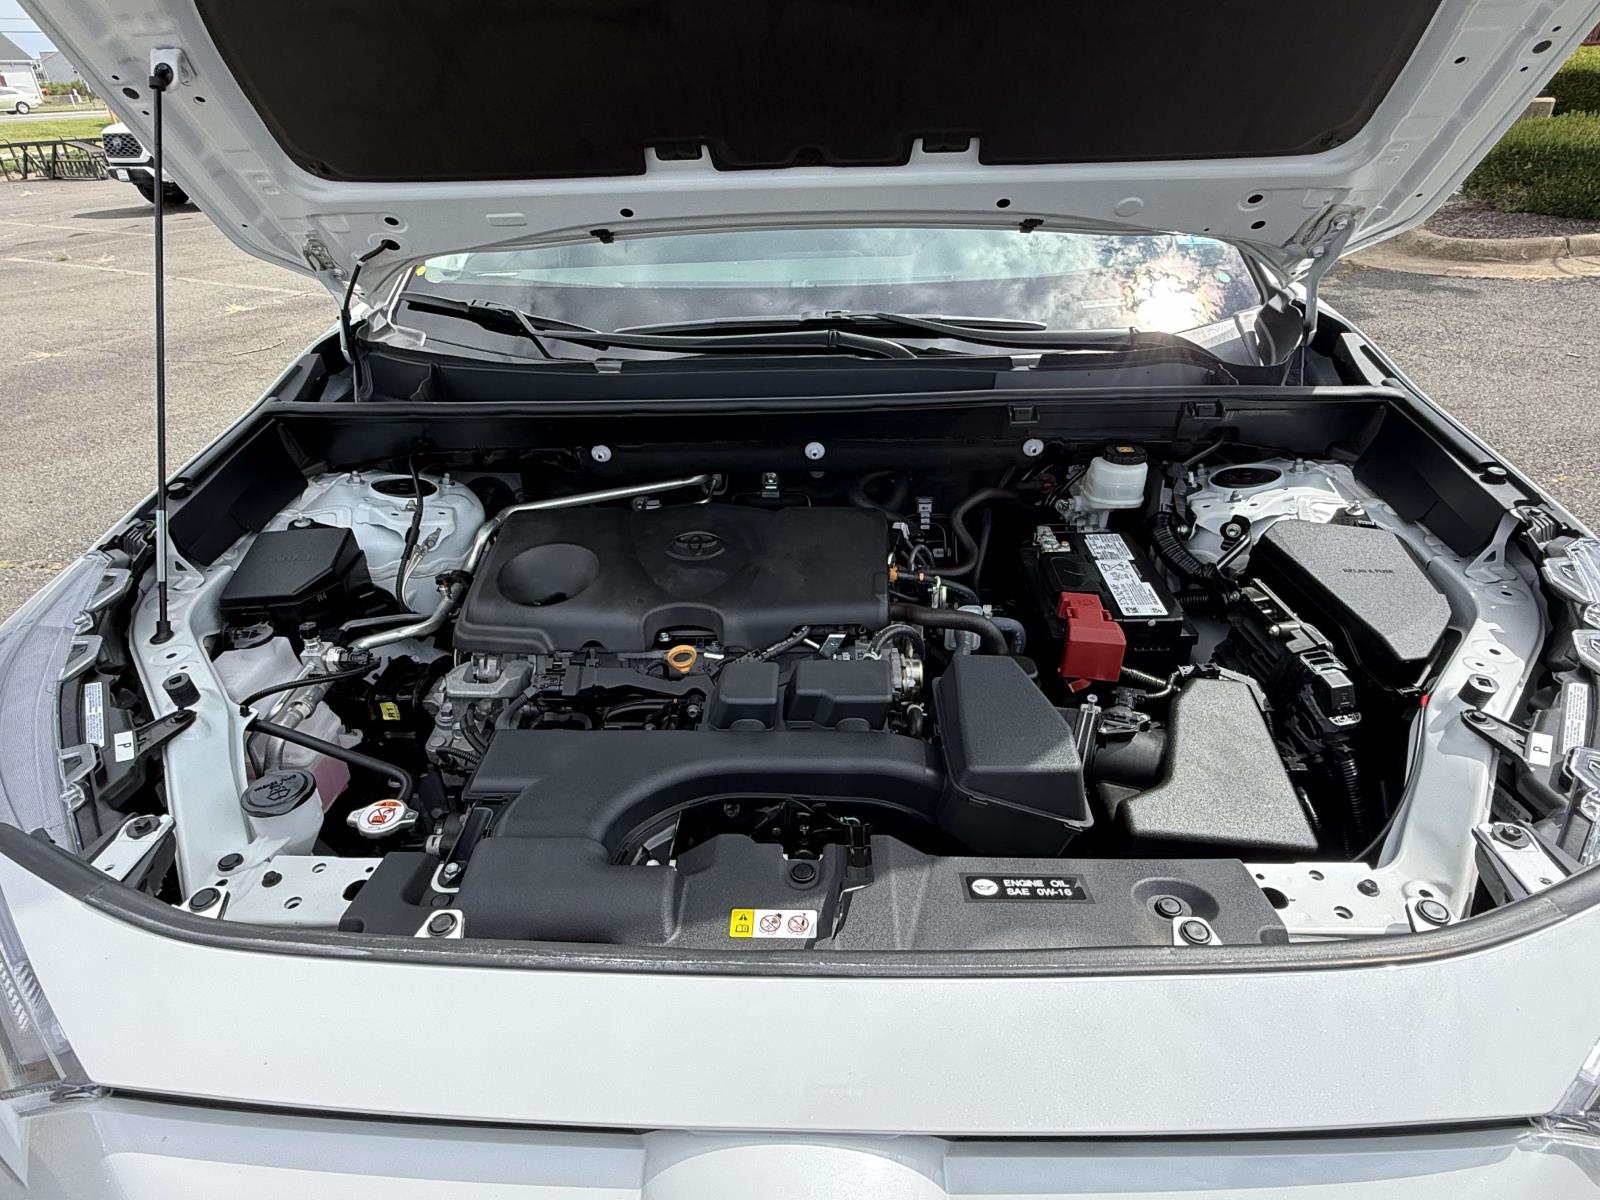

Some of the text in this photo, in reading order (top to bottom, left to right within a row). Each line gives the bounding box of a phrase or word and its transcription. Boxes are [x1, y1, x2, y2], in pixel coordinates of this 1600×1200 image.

[1532, 745, 1549, 754] P
[1003, 879, 1070, 888] ENGINE OIL
[1007, 888, 1073, 897] SAE 0W-16
